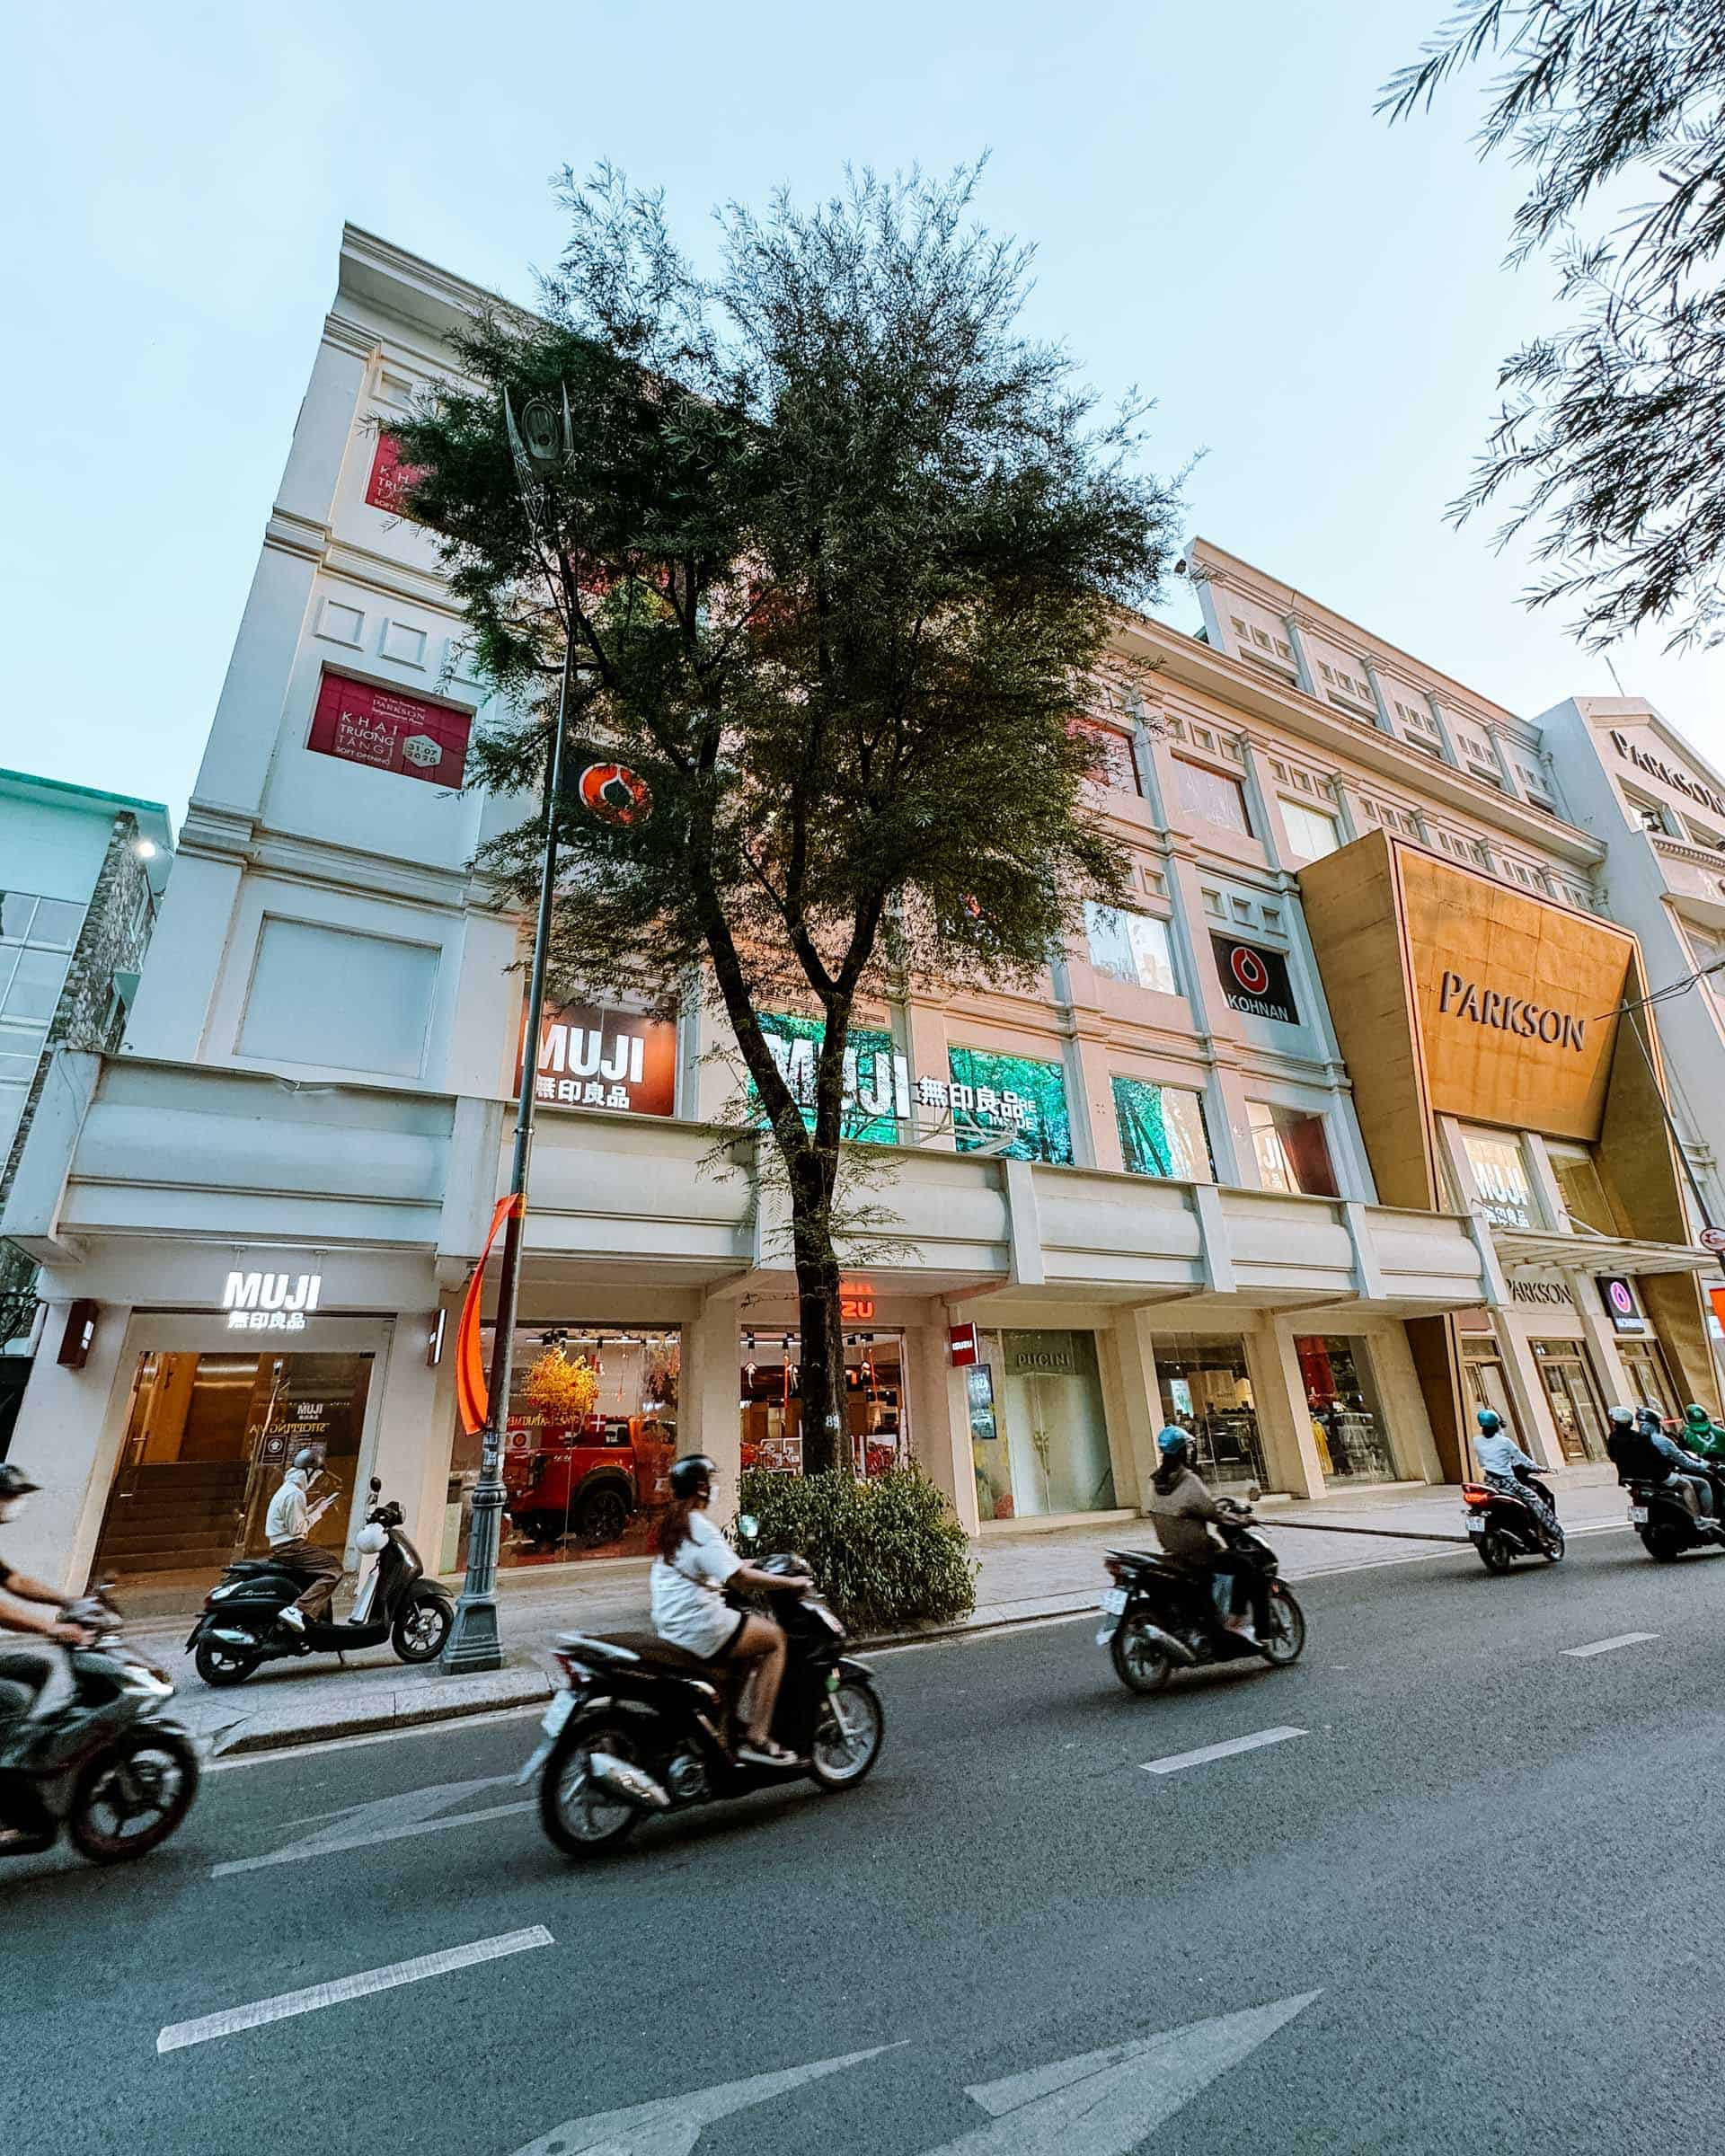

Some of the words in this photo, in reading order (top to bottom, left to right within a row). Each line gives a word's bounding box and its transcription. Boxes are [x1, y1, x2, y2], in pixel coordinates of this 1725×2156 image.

[341, 711, 398, 735] KHAI
[373, 699, 425, 720] PARKSON
[1609, 729, 1725, 817] PARKSON
[1227, 993, 1288, 1021] KOHNAN
[1439, 970, 1586, 1053] PARKSON
[521, 1020, 644, 1083] MUJI
[535, 1074, 631, 1109] 無印良品
[919, 1076, 1024, 1120] 無印良品
[223, 1271, 322, 1311] MUJI
[227, 1311, 306, 1330] 無印良品
[1016, 1351, 1073, 1366] PUCINI
